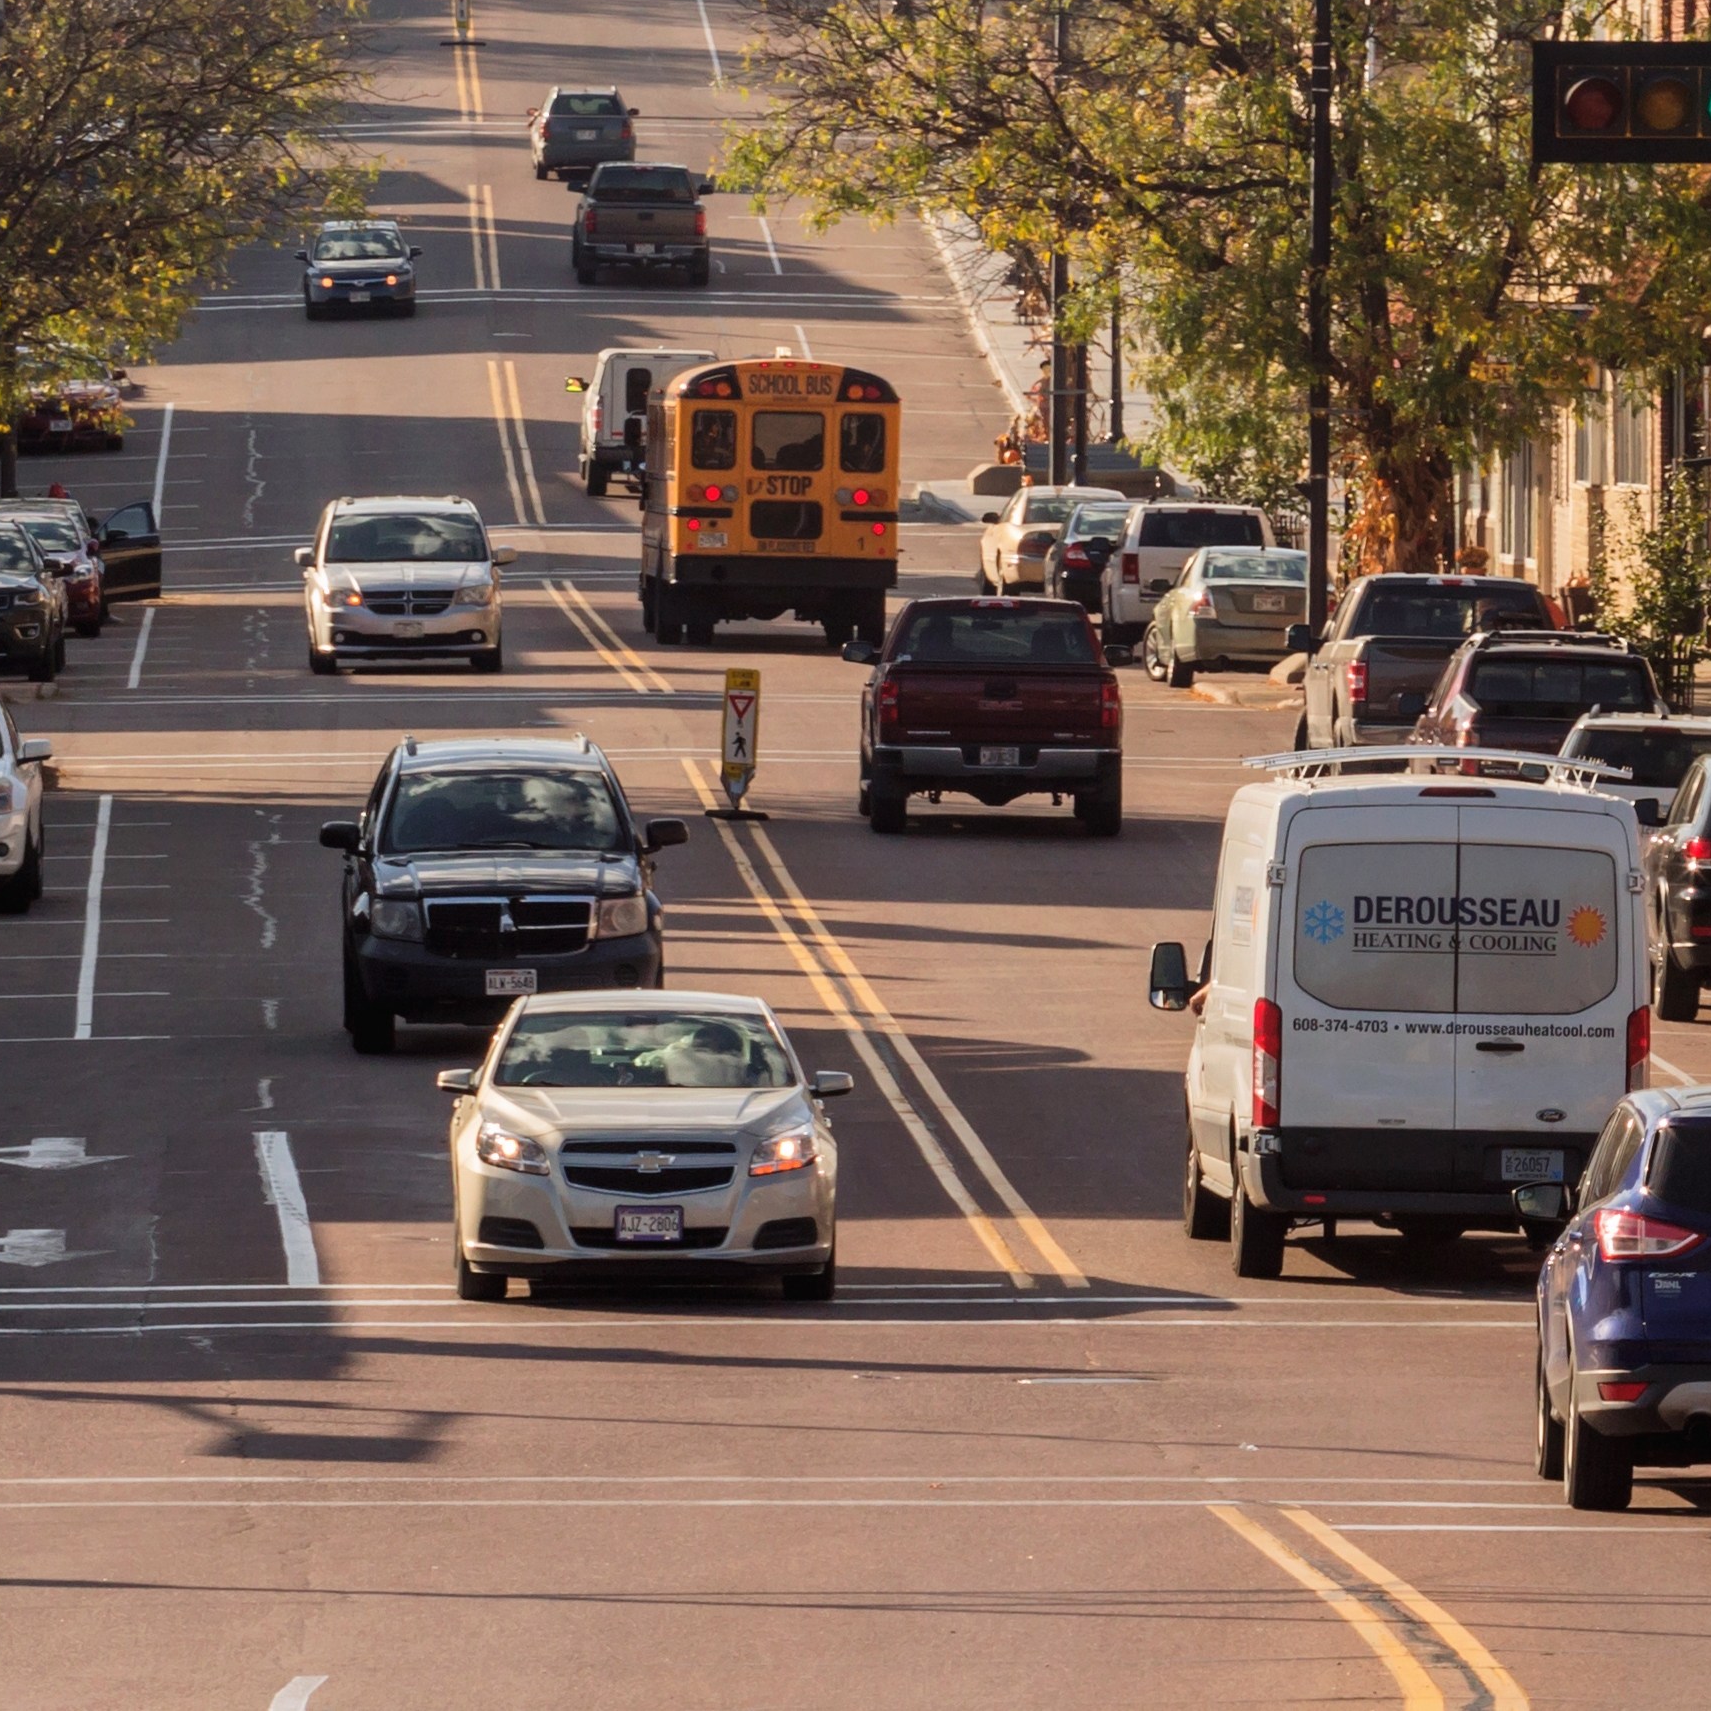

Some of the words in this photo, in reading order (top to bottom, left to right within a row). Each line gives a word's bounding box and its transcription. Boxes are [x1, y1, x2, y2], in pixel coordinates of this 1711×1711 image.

[748, 374, 801, 395] SCHOOL
[806, 375, 833, 395] BUS
[766, 475, 813, 495] STOP
[857, 537, 865, 550] 1
[1352, 896, 1561, 928] DEROUSSEAU
[1353, 932, 1441, 950] HEATING
[1448, 934, 1462, 950] &
[1468, 933, 1558, 952] COOLING
[1292, 1017, 1389, 1034] 608-374-4703
[1404, 1020, 1616, 1039] www.derousseauheatcool.com
[1513, 1156, 1551, 1173] 26057
[619, 1215, 678, 1233] AJZ-2806
